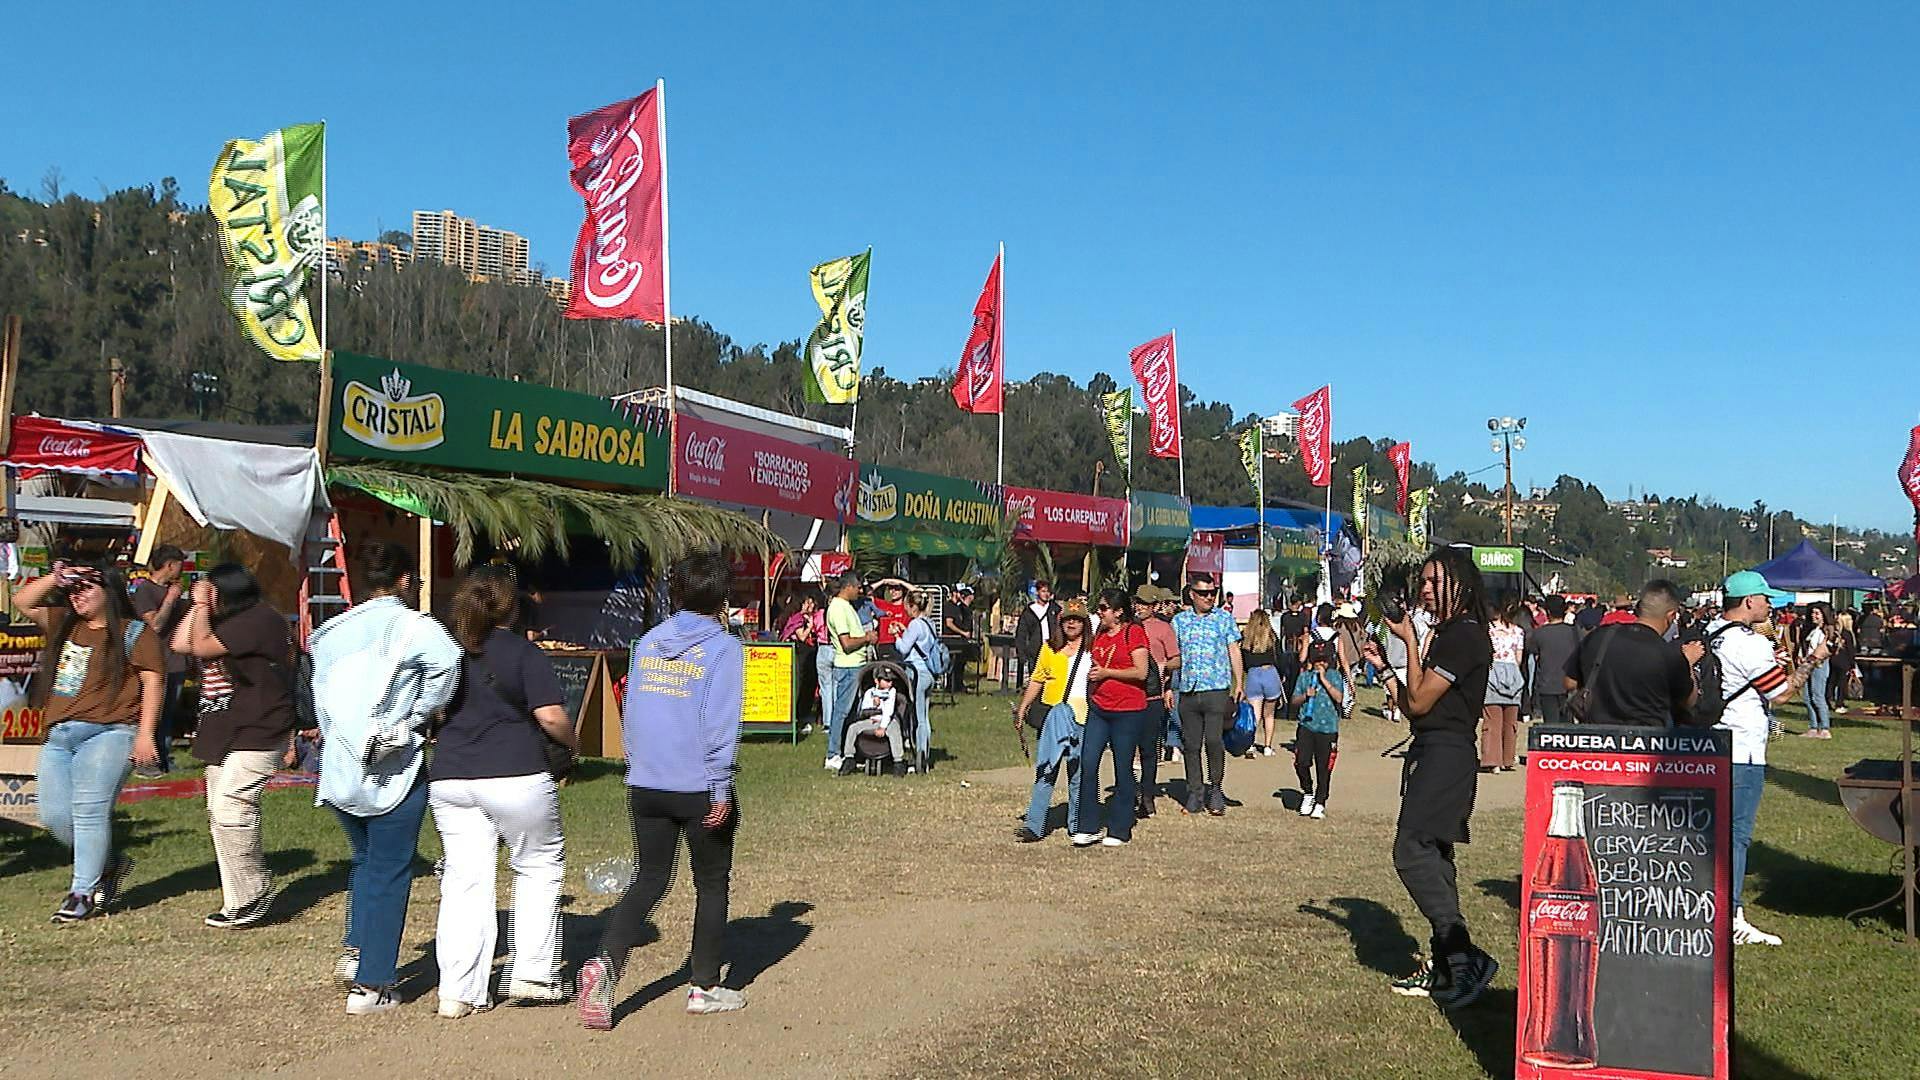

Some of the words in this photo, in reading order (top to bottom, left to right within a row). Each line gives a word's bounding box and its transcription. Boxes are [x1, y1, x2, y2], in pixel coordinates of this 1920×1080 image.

[352, 395, 435, 436] CRISTAL
[490, 410, 524, 451] LA
[535, 416, 645, 467] SABROSA
[750, 466, 757, 483] Y
[904, 489, 941, 520] DOÑA
[945, 498, 1000, 526] AGUSTINA
[1480, 551, 1514, 566] BAÑOS
[1540, 734, 1617, 750] PRUEBA
[1621, 736, 1646, 750] LA
[1651, 737, 1716, 752] NUEVA
[1538, 758, 1622, 772] COCA-COLA
[1625, 760, 1650, 773] SIN
[1654, 760, 1717, 775] AZÚCAR
[1594, 833, 1709, 857] CERVEZAS
[1536, 899, 1590, 921] Coca-Cola
[1601, 886, 1716, 923] EMPANADAS
